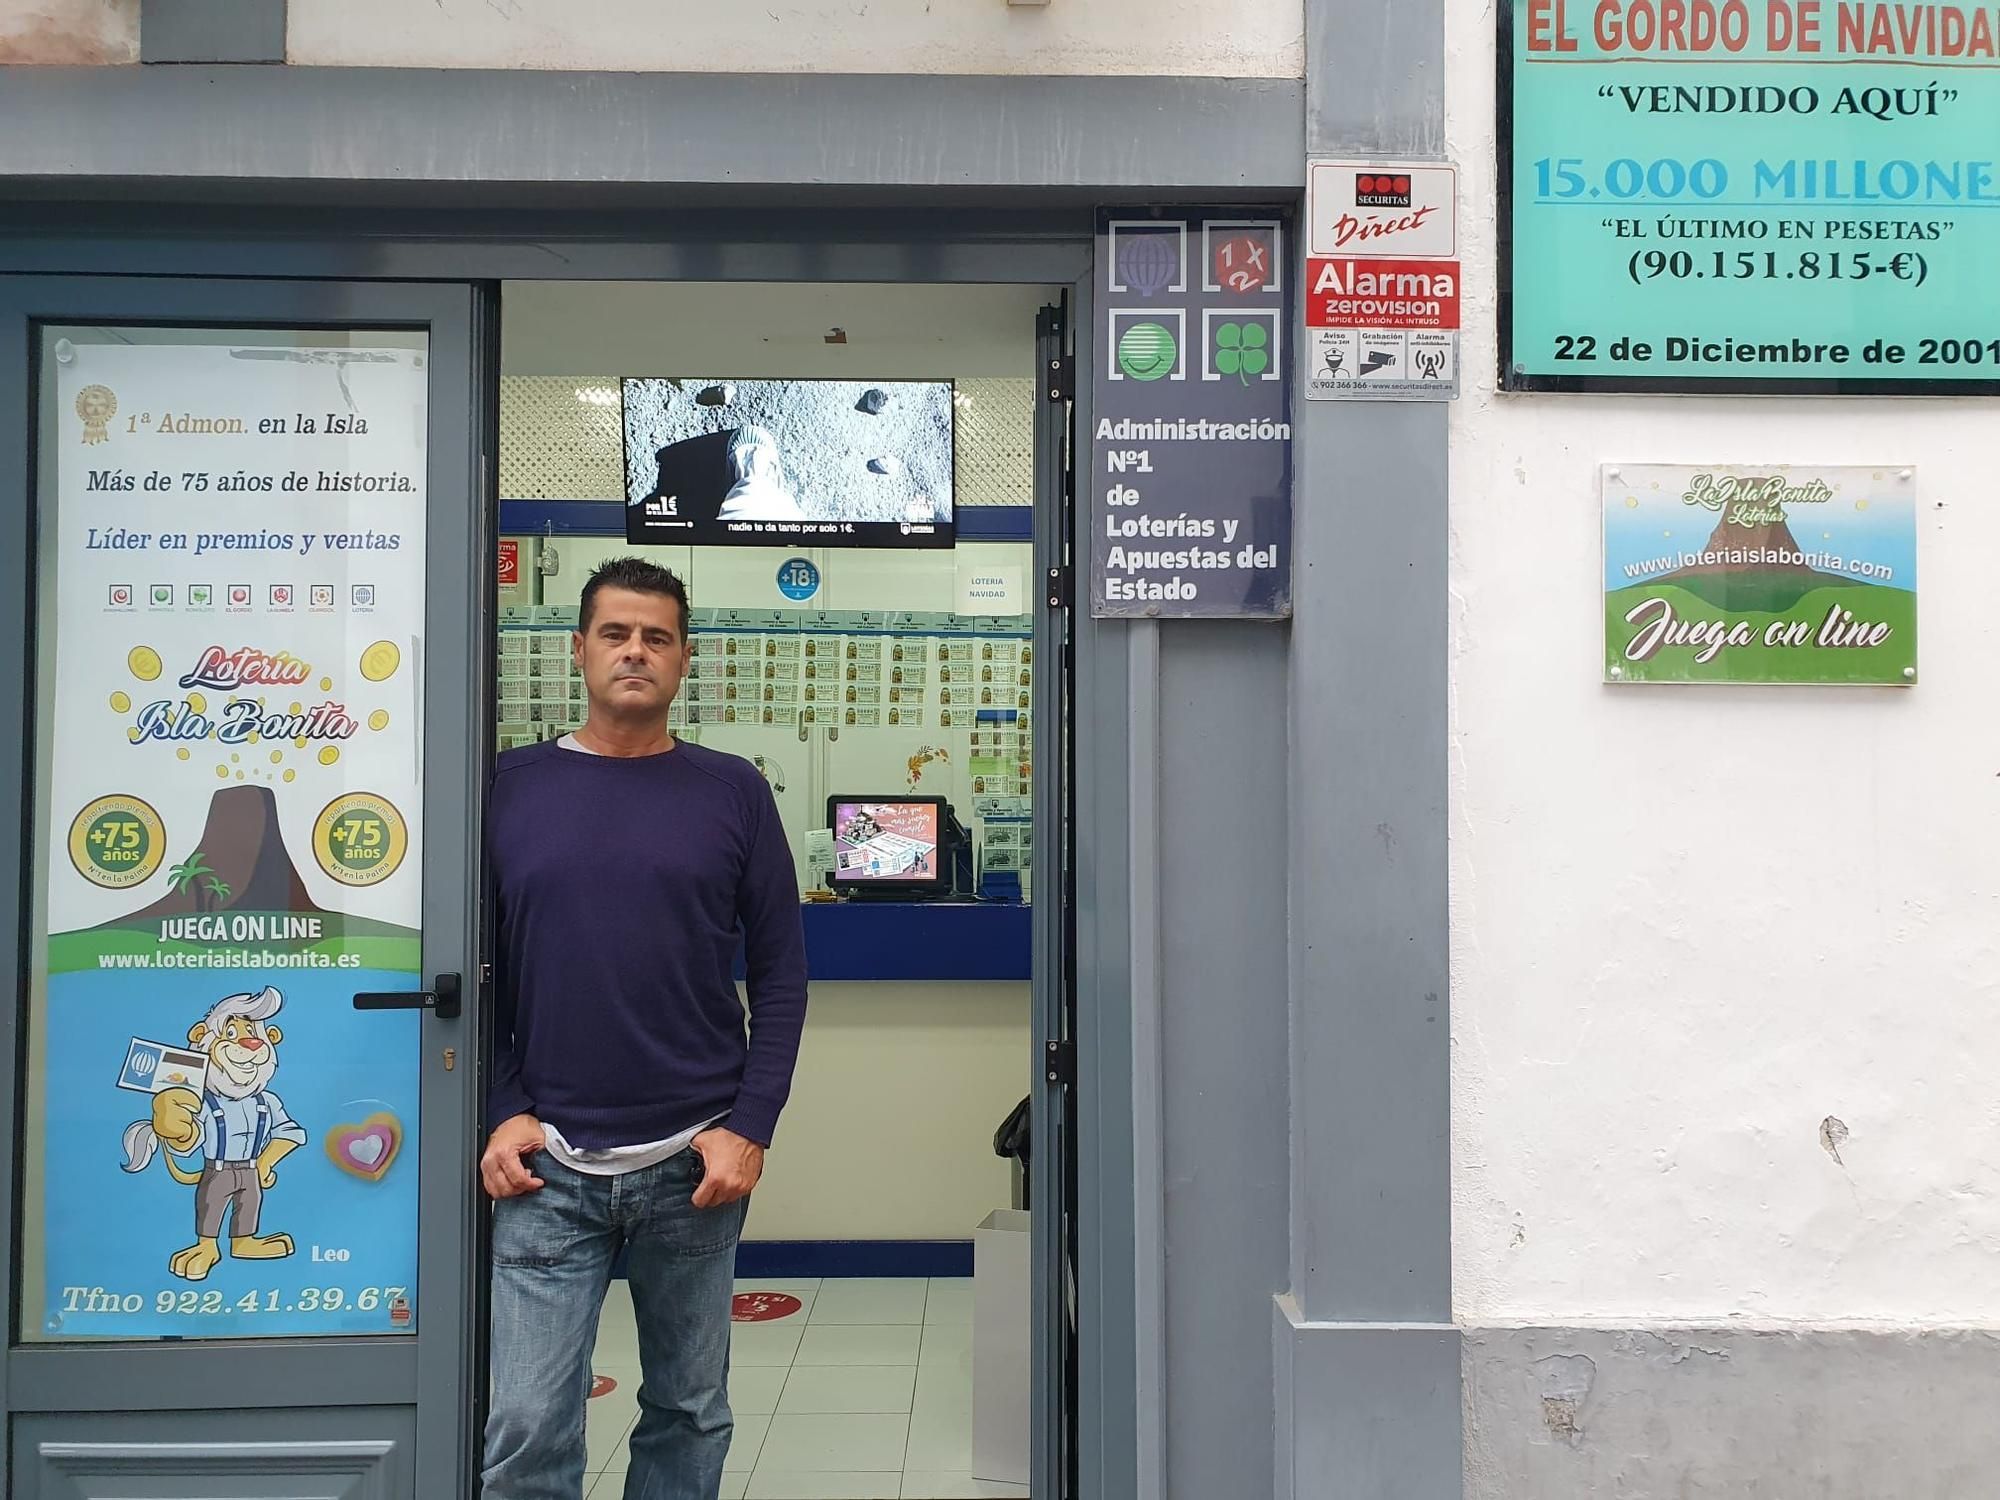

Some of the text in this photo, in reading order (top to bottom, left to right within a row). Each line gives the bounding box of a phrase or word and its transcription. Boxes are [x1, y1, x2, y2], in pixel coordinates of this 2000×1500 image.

[1527, 0, 2000, 57] EL GORDO DE NAVIDA
[1534, 157, 1728, 199] 15.000
[1358, 195, 1409, 205] SECURITAS
[1331, 205, 1440, 247] Direct
[1657, 214, 1768, 239] ÚLTIMO
[1778, 220, 1815, 239] EN
[1313, 263, 1453, 297] Alarma
[1629, 250, 1928, 287] (90.151.815-€)
[1326, 300, 1440, 315] zerovision
[1326, 316, 1352, 324] IMPIDE
[1366, 316, 1391, 324] VISIÓN
[1362, 332, 1403, 340] Grabación
[1554, 336, 2000, 364] 22 de Diciembre de 2001
[126, 411, 369, 435] 1ª Admon. en la Isla
[1096, 418, 1290, 441] Administración
[1107, 451, 1153, 473] Nº1
[86, 469, 418, 493] Más de 75 años de historia.
[1760, 475, 1832, 507] Bonita
[1107, 484, 1140, 506] de
[728, 522, 753, 532] nadie
[754, 523, 763, 532] te
[765, 523, 777, 532] da
[779, 523, 801, 532] tanto
[802, 525, 817, 534] por
[819, 523, 838, 533] solo
[1107, 513, 1239, 543] Loterías y
[86, 527, 401, 555] Líder en premios y ventas
[1107, 545, 1276, 574] Apuestas del
[1624, 547, 1893, 580] www.loteriaislabonita.com
[1106, 578, 1197, 601] Estado
[1625, 597, 1894, 664] Juega on line
[178, 645, 312, 691] Lotería
[130, 699, 358, 745] Isla Bonita
[90, 822, 140, 848] +75
[333, 820, 381, 846] +75
[103, 848, 140, 861] años
[344, 845, 381, 859] años
[124, 865, 148, 882] Palma
[366, 862, 389, 879] Palma
[158, 916, 322, 943] JUEGA ON LINE
[98, 949, 361, 970] www.loteriaislabonita.es
[311, 1246, 350, 1263] Leo
[62, 1286, 407, 1314] Tfno 922.41.39.67
